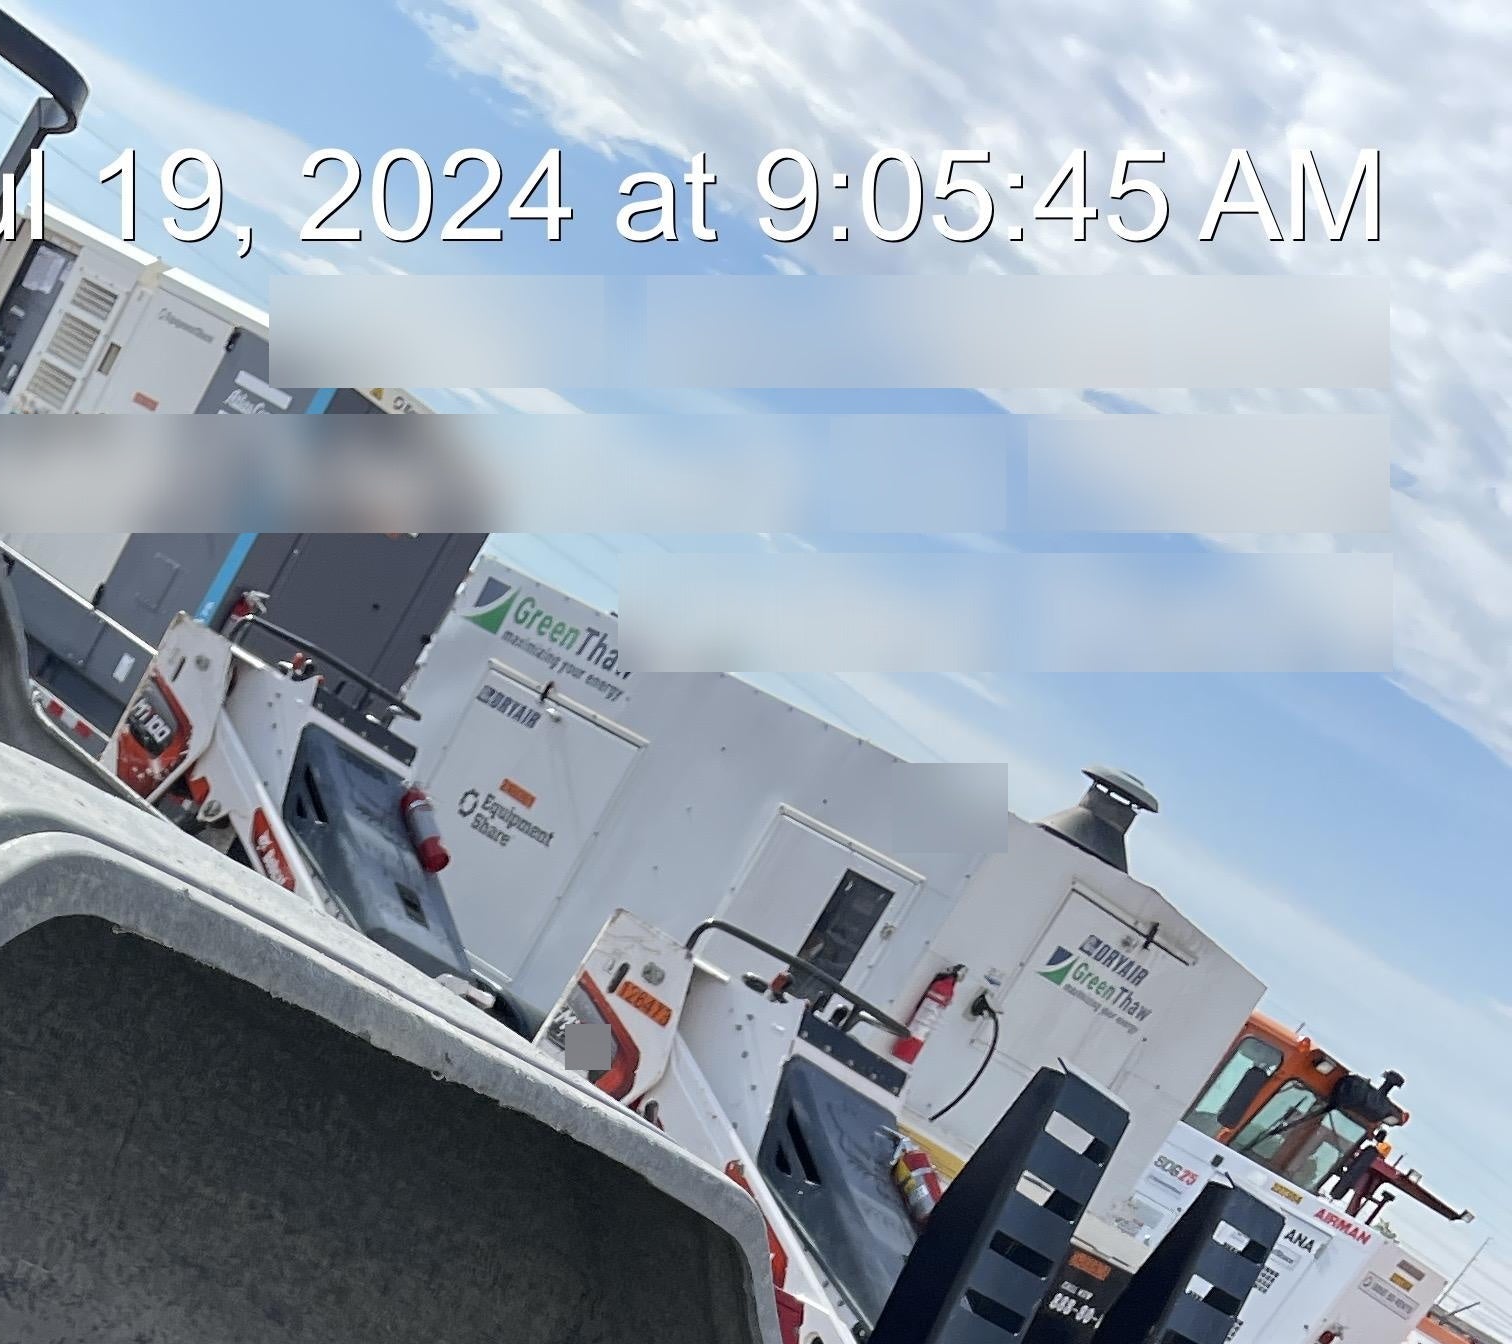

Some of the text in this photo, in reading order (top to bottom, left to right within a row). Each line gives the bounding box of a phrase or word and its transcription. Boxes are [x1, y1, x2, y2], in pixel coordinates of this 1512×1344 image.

[471, 812, 512, 847] Share
[481, 793, 555, 848] Equipment
[1092, 943, 1150, 987] DRYAIR
[1071, 961, 1153, 1022] GreenThaw
[1284, 1229, 1317, 1254] ANA
[1313, 1207, 1372, 1246] AIRMAN
